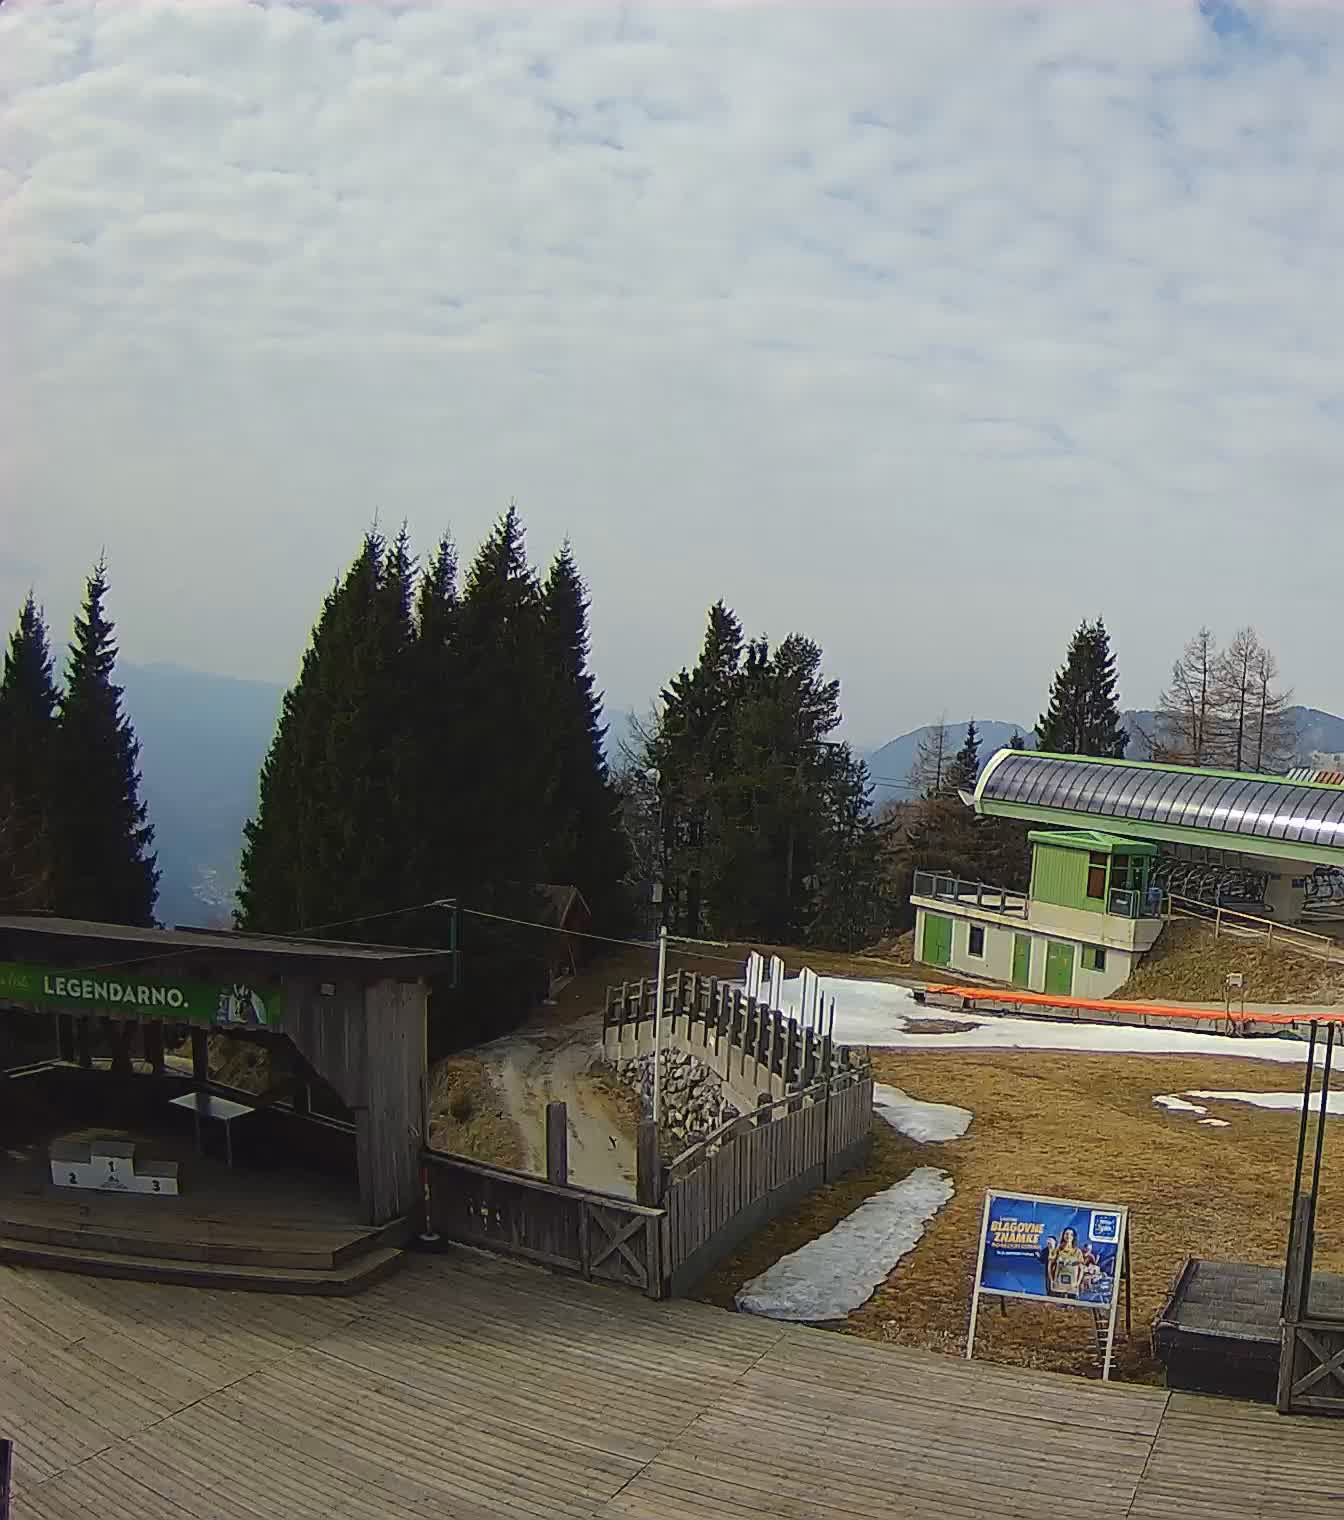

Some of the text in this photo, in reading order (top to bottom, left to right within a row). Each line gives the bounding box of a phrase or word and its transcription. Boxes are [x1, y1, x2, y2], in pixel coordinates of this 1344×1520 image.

[43, 975, 189, 1008] LEGENDARNO.
[108, 1161, 115, 1172] 1
[69, 1172, 78, 1184] 2
[152, 1180, 160, 1192] 3
